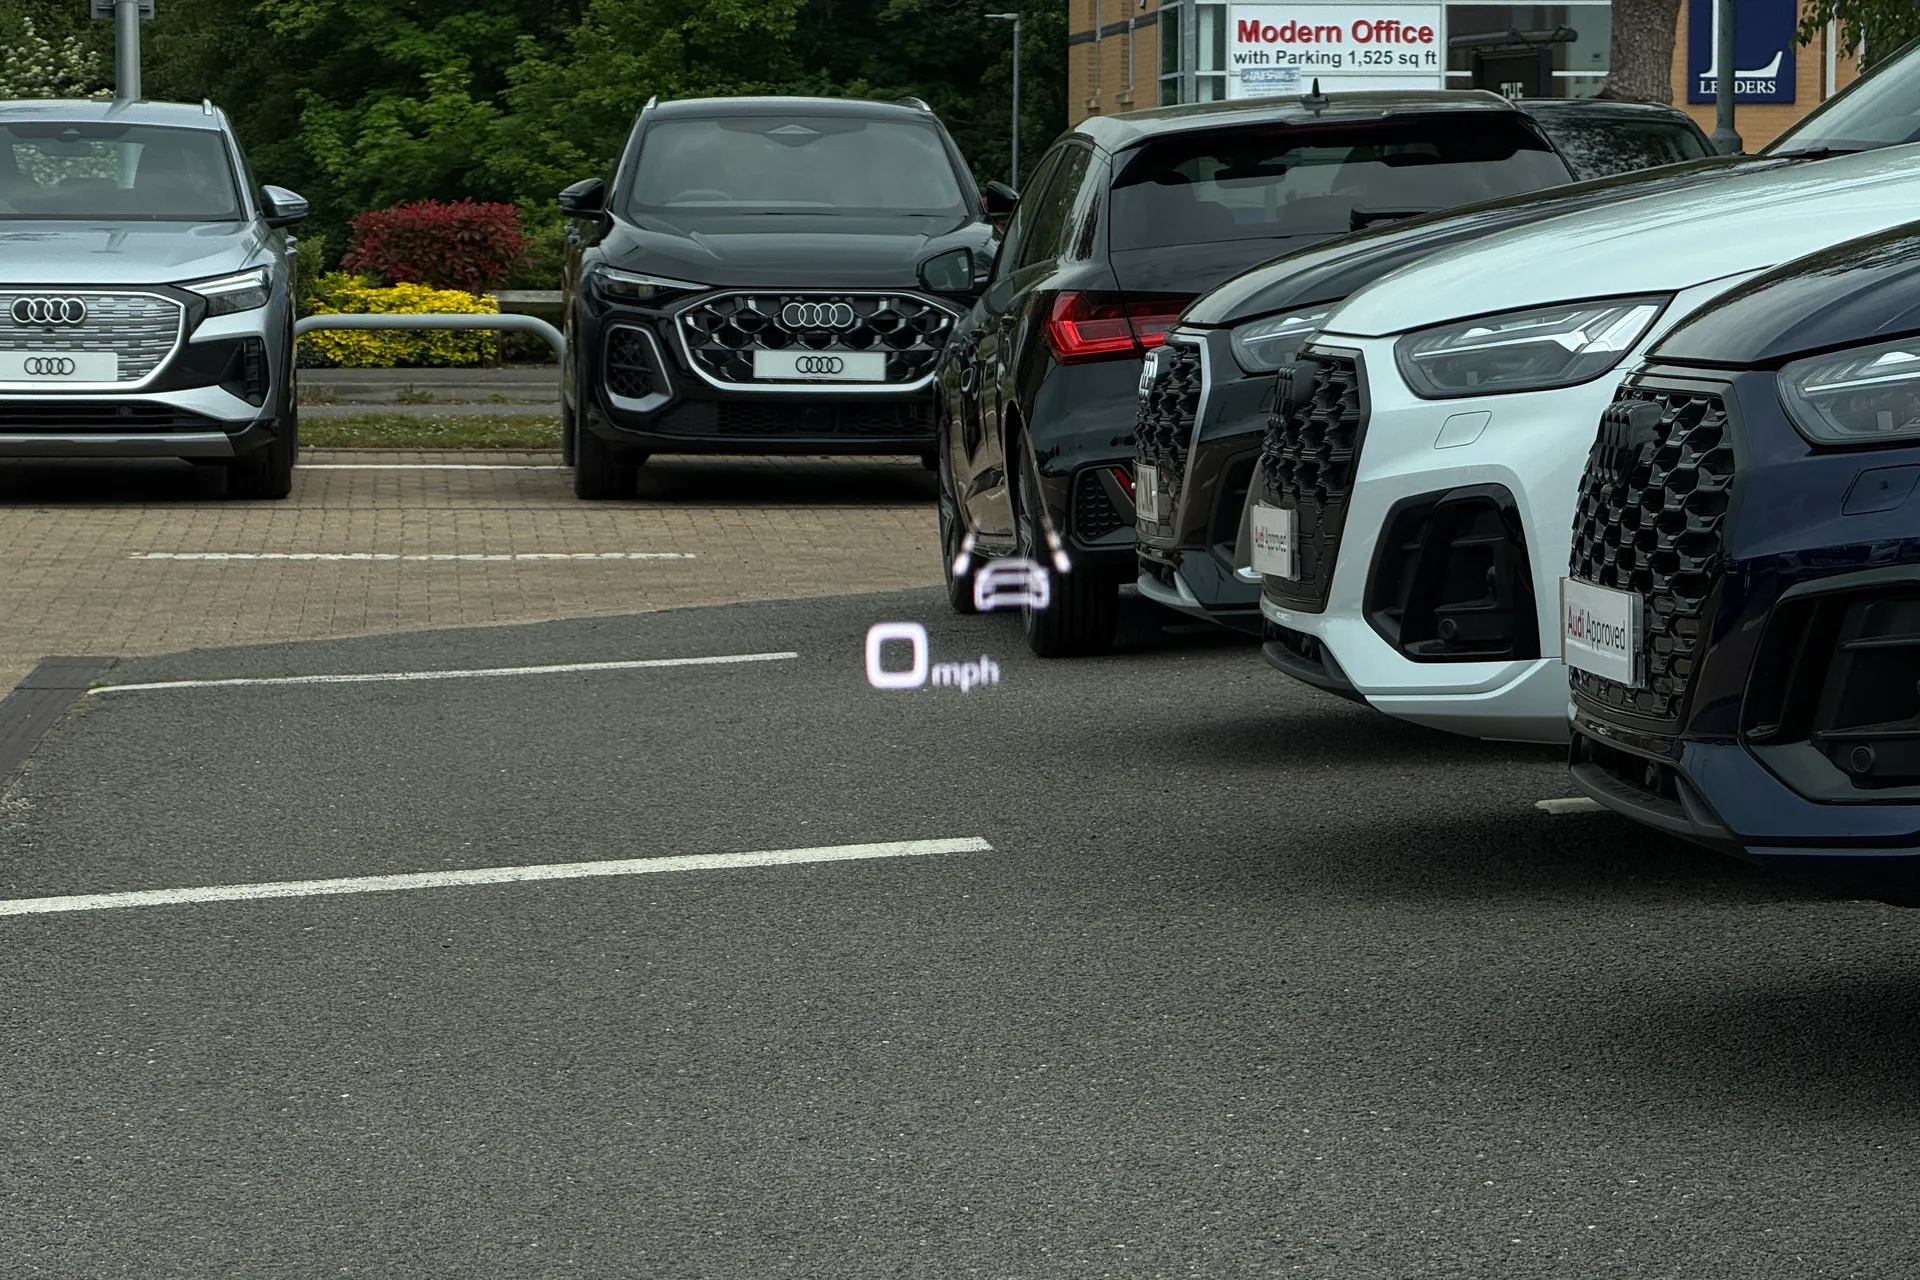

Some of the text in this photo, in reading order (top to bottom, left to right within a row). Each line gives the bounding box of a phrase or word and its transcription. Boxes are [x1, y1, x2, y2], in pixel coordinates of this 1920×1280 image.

[1237, 19, 1435, 44] Modern Office
[1233, 50, 1438, 68] with Parking 1,525 sq ft
[1699, 80, 1776, 94] LEDERS
[1567, 605, 1626, 650] Audi Approved
[865, 622, 1001, 694] 0 mph
